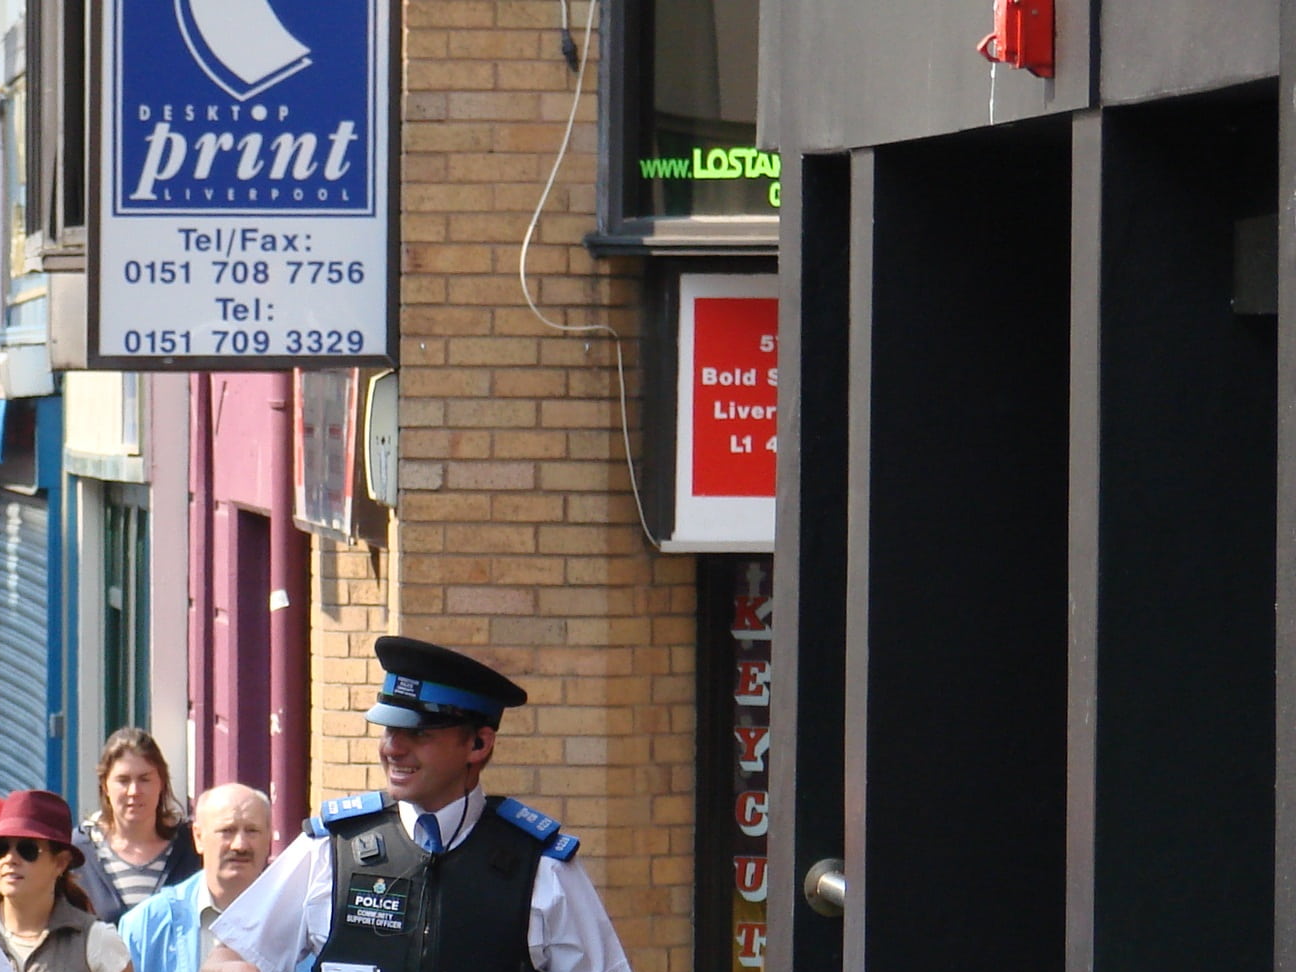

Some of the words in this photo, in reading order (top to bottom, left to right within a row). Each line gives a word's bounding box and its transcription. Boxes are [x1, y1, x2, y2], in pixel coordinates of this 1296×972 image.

[129, 120, 358, 201] print
[163, 188, 350, 201] LIVERPOOL
[178, 227, 312, 259] Tel/Fax:
[124, 260, 192, 285] 0151
[211, 260, 270, 285] 708
[285, 260, 365, 285] 7756
[215, 298, 275, 322] Tel:
[124, 330, 192, 355] 0151
[211, 330, 271, 355] 709
[285, 330, 364, 355] 3329
[759, 334, 778, 353] 5
[702, 366, 757, 387] Bold
[729, 434, 753, 454] L1
[355, 895, 400, 911] POLICE
[346, 914, 375, 926] SUPPORT
[375, 918, 402, 929] OFFICER
[357, 909, 394, 920] COMMUNITY
